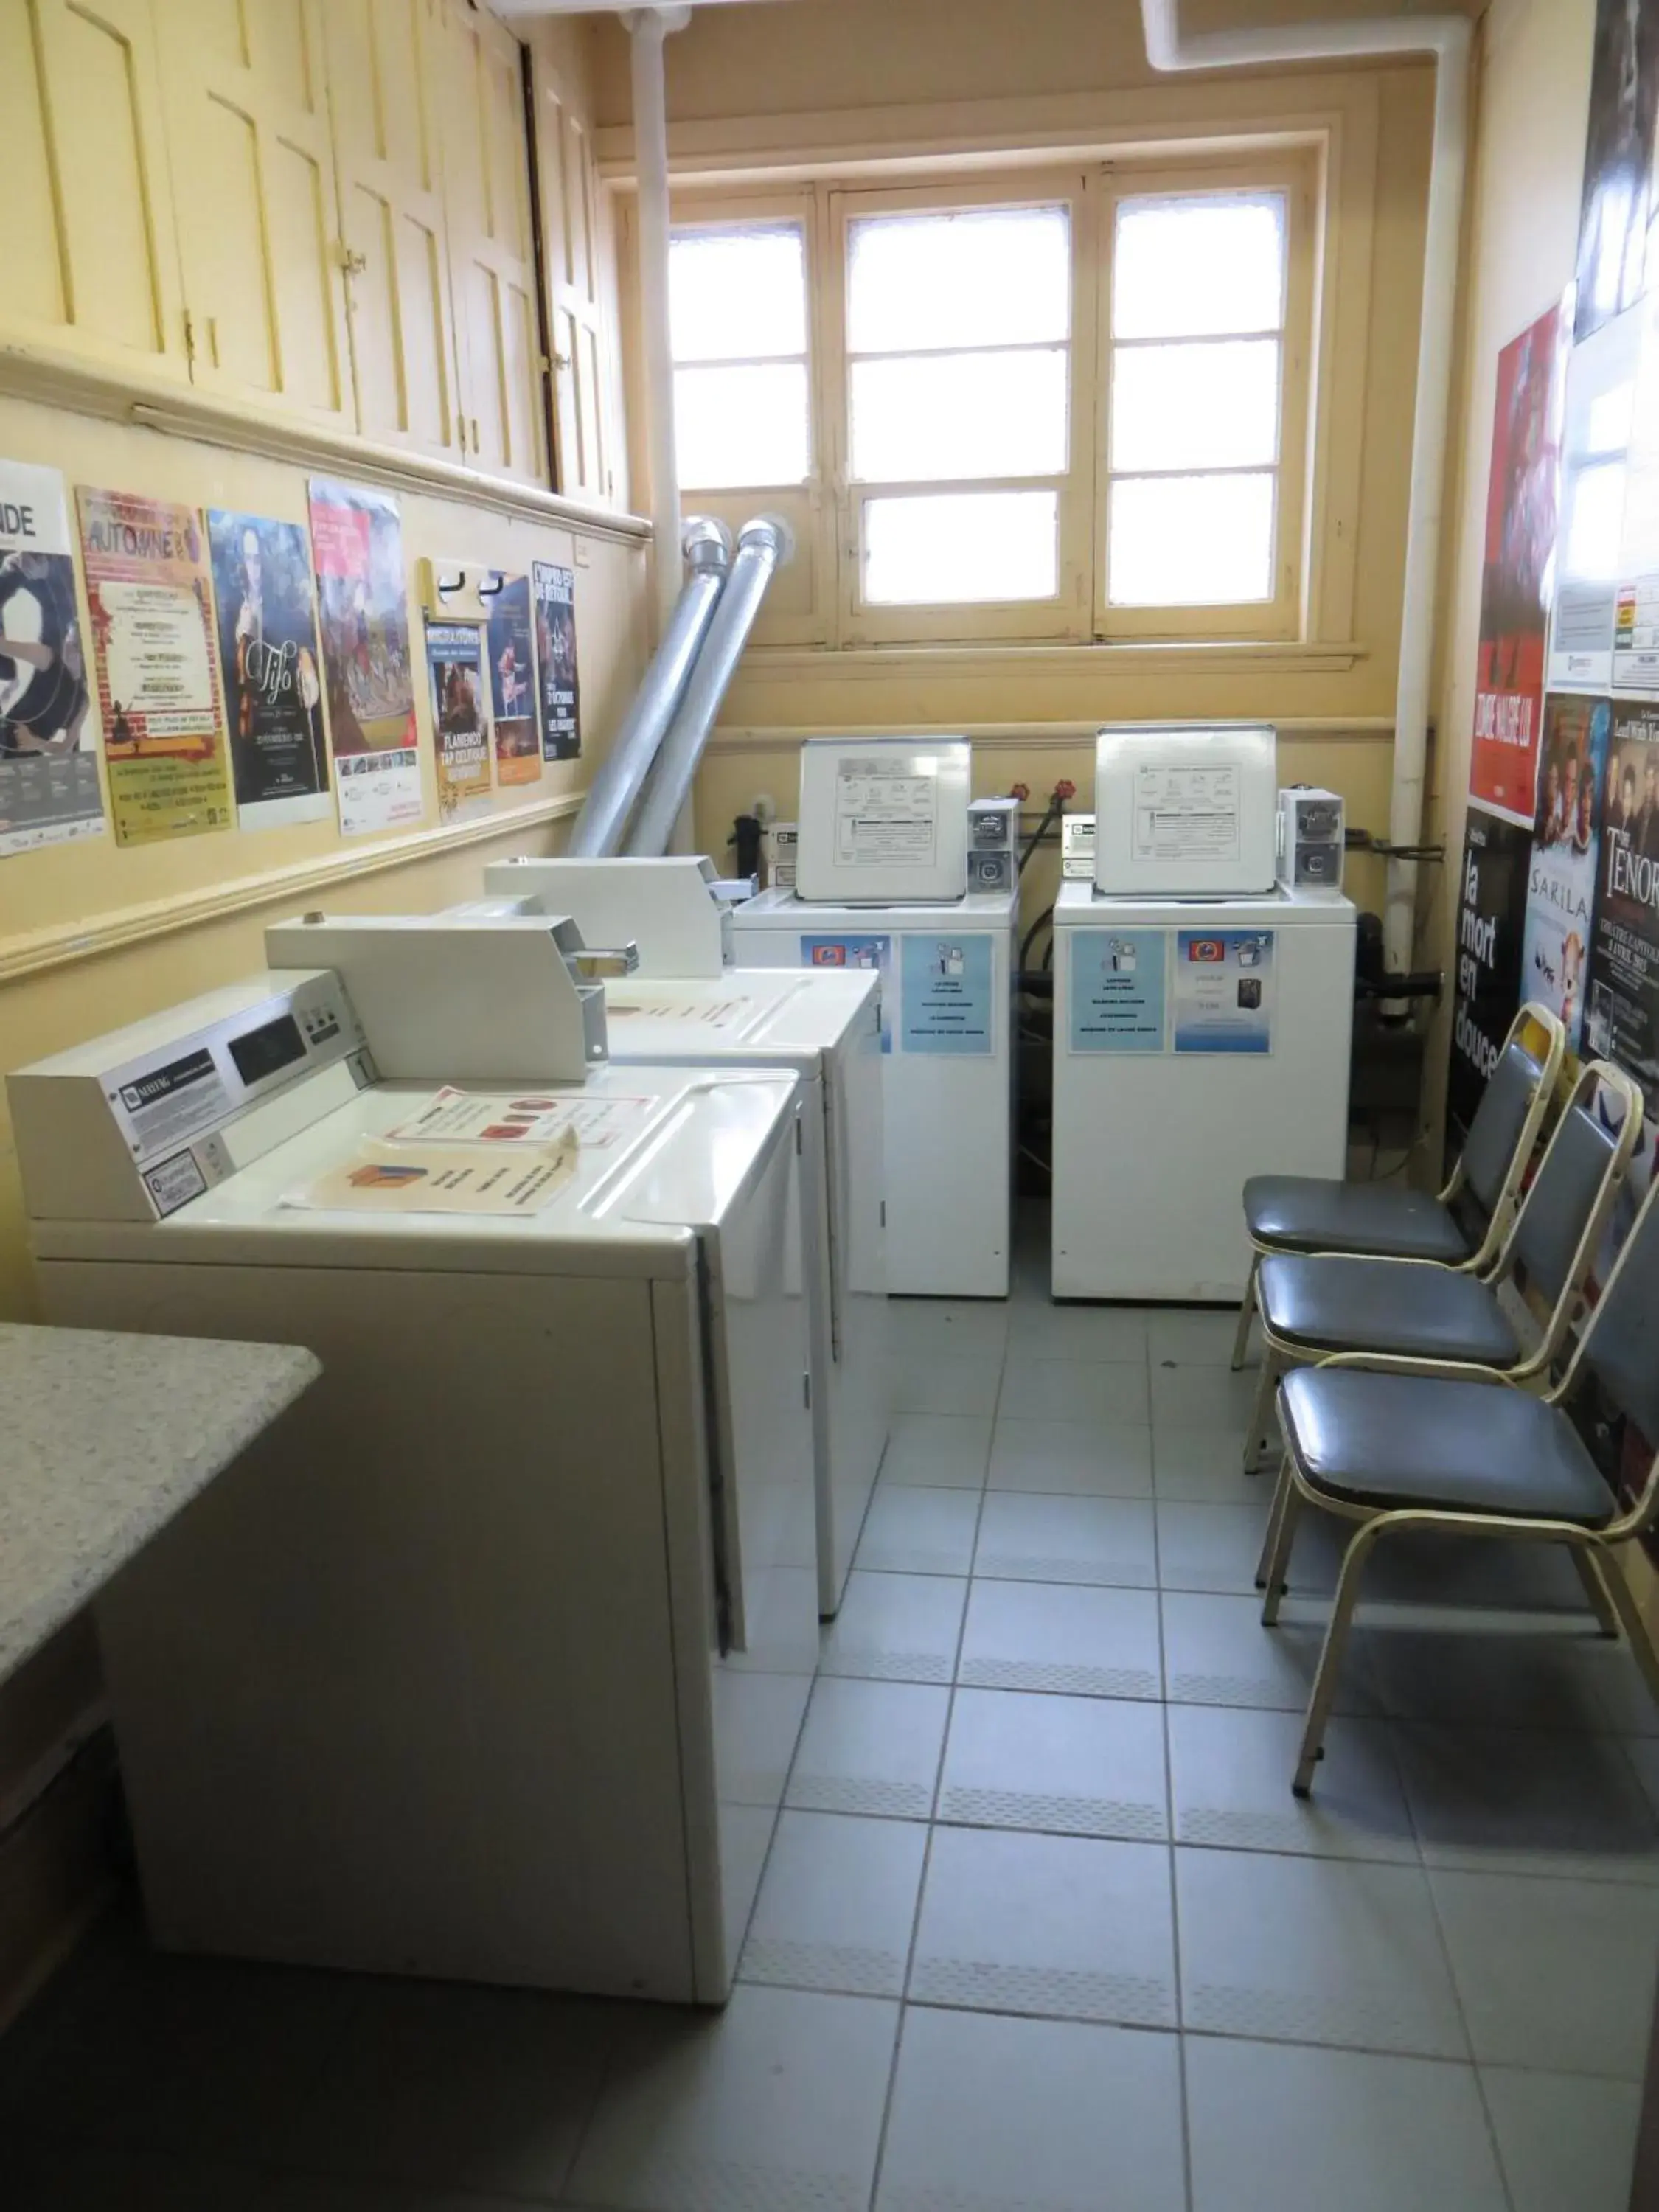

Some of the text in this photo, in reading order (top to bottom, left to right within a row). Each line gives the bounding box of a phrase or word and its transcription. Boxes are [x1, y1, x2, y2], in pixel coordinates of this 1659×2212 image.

[89, 519, 174, 560] AUTOMNE
[1465, 849, 1478, 905] la
[1531, 868, 1589, 922] SARILA
[1461, 908, 1496, 969] mort
[1459, 953, 1477, 1001] en
[1455, 1001, 1500, 1080] douce
